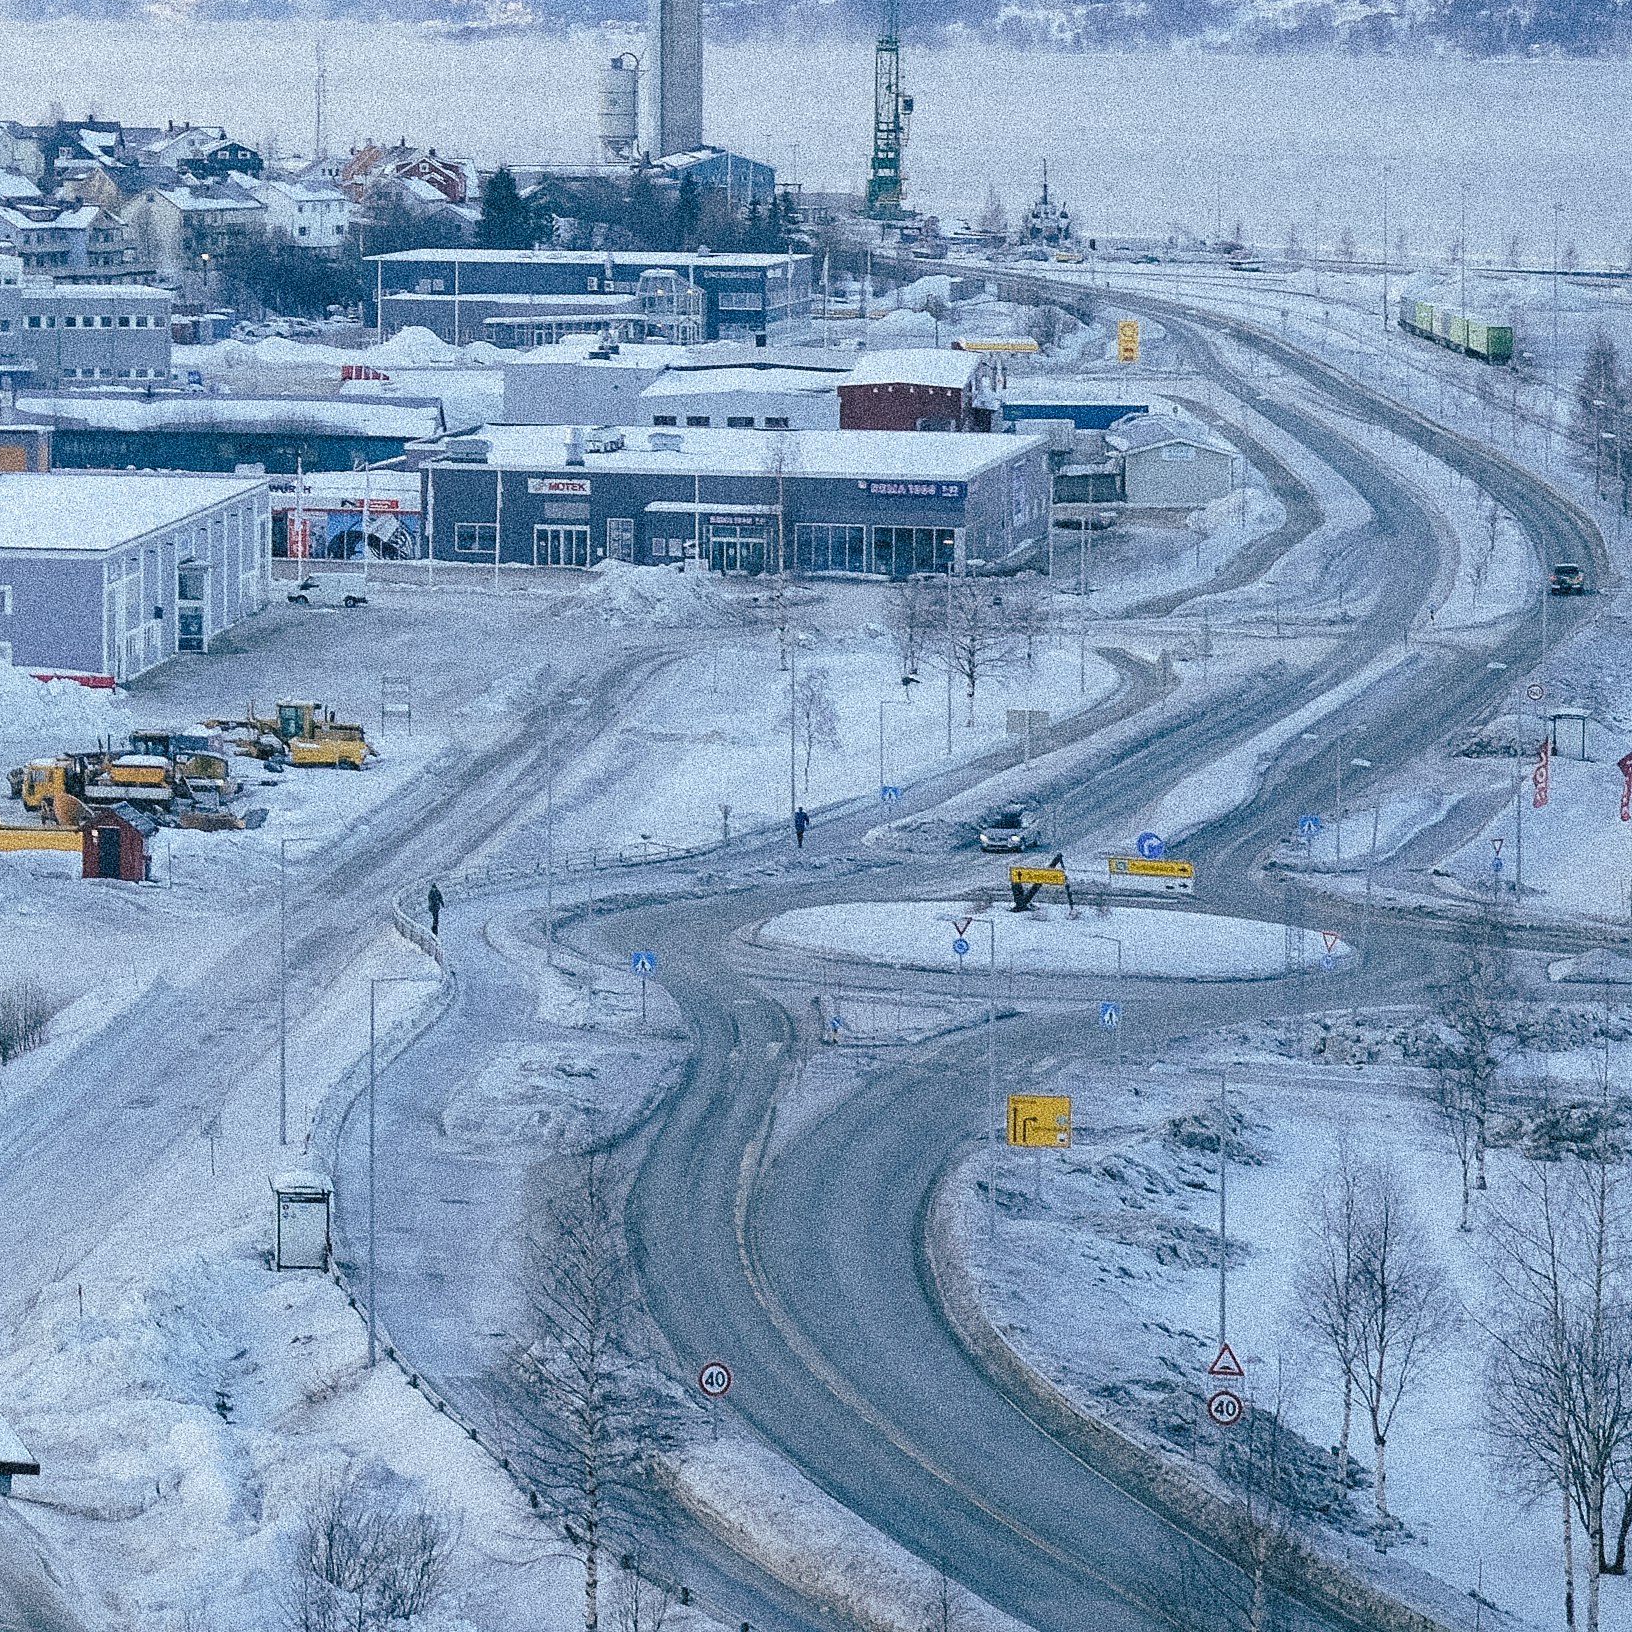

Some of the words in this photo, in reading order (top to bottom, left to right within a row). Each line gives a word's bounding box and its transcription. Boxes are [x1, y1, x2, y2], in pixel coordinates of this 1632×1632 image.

[268, 482, 312, 494] WÜRH
[548, 482, 587, 492] MOTEK
[705, 1371, 726, 1388] 40
[1214, 1400, 1236, 1417] 40
